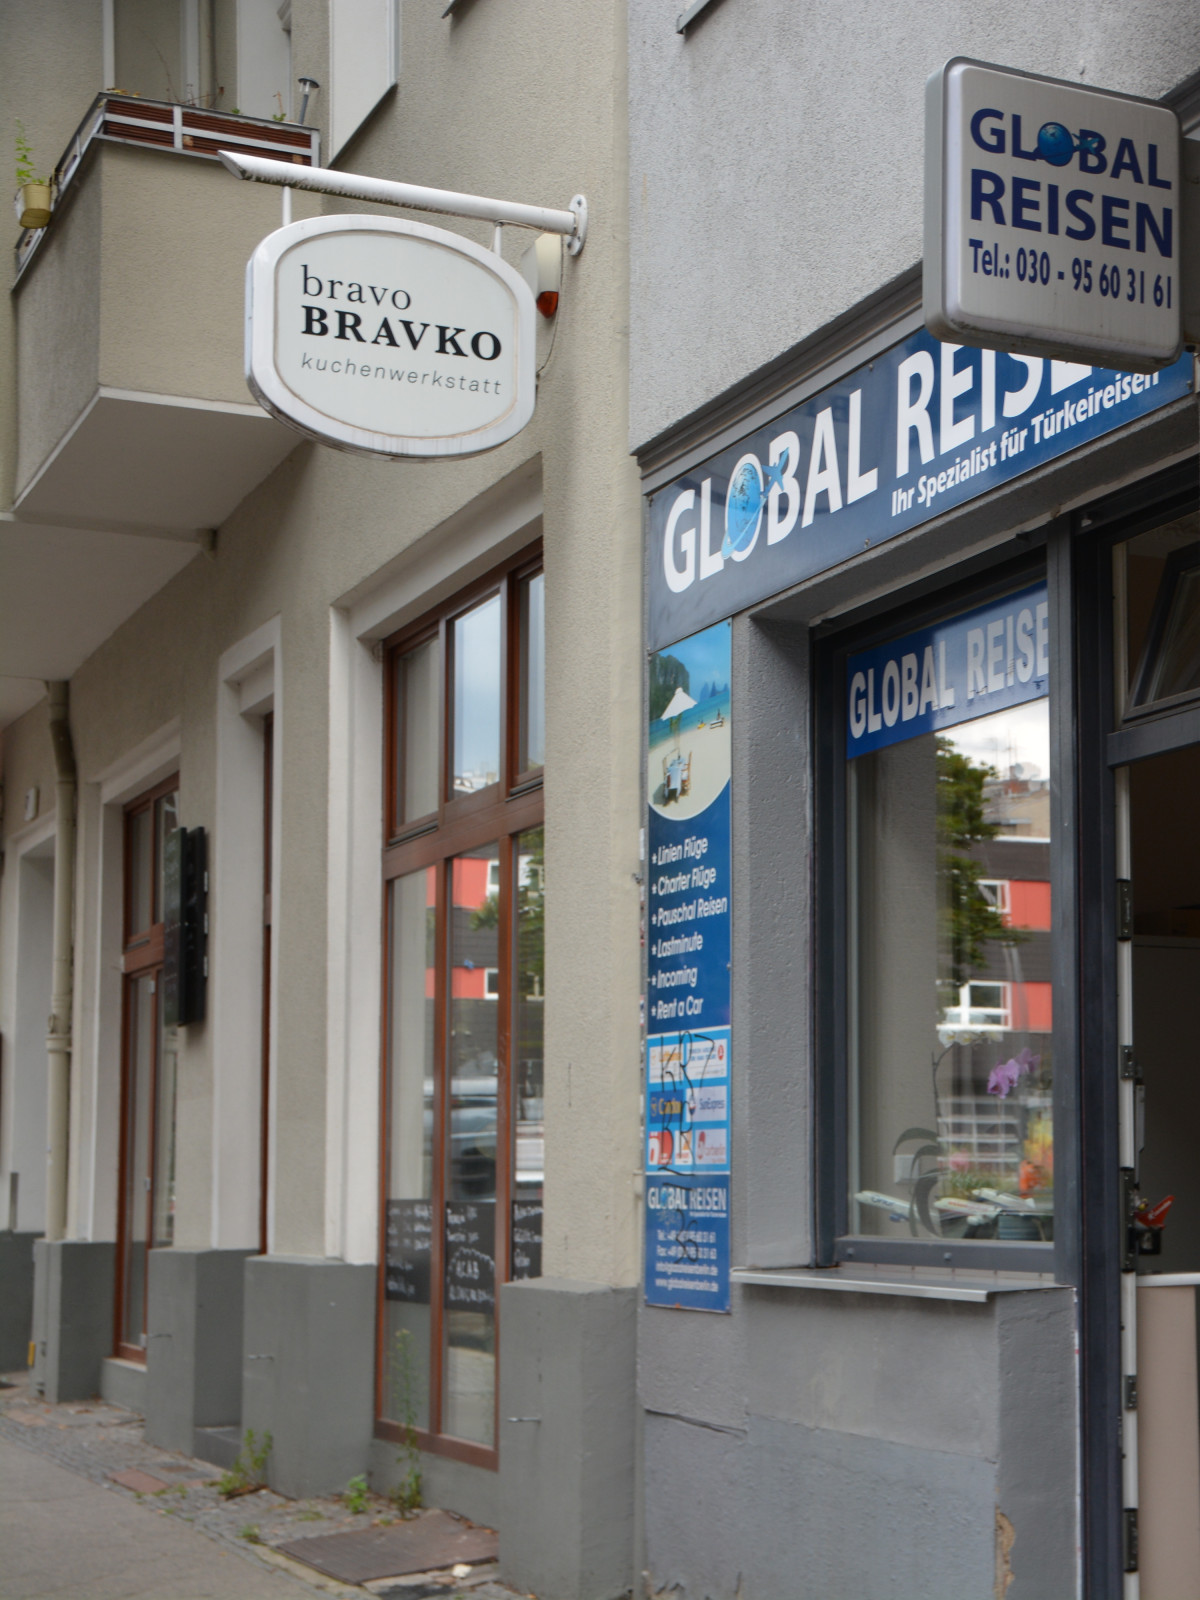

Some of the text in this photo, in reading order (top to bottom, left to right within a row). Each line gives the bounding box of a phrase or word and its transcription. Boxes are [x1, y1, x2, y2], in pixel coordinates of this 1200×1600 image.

[970, 108, 1172, 190] GLOBAL
[971, 168, 1173, 258] REISEN
[300, 264, 412, 310] bravo
[969, 238, 1010, 279] Tel.:
[1016, 247, 1051, 286] 030
[1072, 257, 1093, 294] 95
[1099, 263, 1121, 299] 60
[1127, 268, 1145, 304] 31
[1153, 274, 1172, 309] 61
[301, 305, 503, 361] BRAVKO
[301, 353, 502, 395] kuchenwerkstatt
[891, 370, 1160, 517] Ihr Spezialist für Türkeireisen
[663, 388, 878, 593] GLOBAL
[850, 640, 955, 739] GLOBAL
[657, 836, 708, 865] Linien Flüge
[658, 866, 716, 896] Charter Flüge
[657, 896, 727, 927] Pauschal Reisen
[657, 931, 703, 958] Lastminute
[657, 966, 698, 988] Incoming
[657, 996, 703, 1019] Rent a Car
[648, 1187, 726, 1211] GLOBAL REISEN
